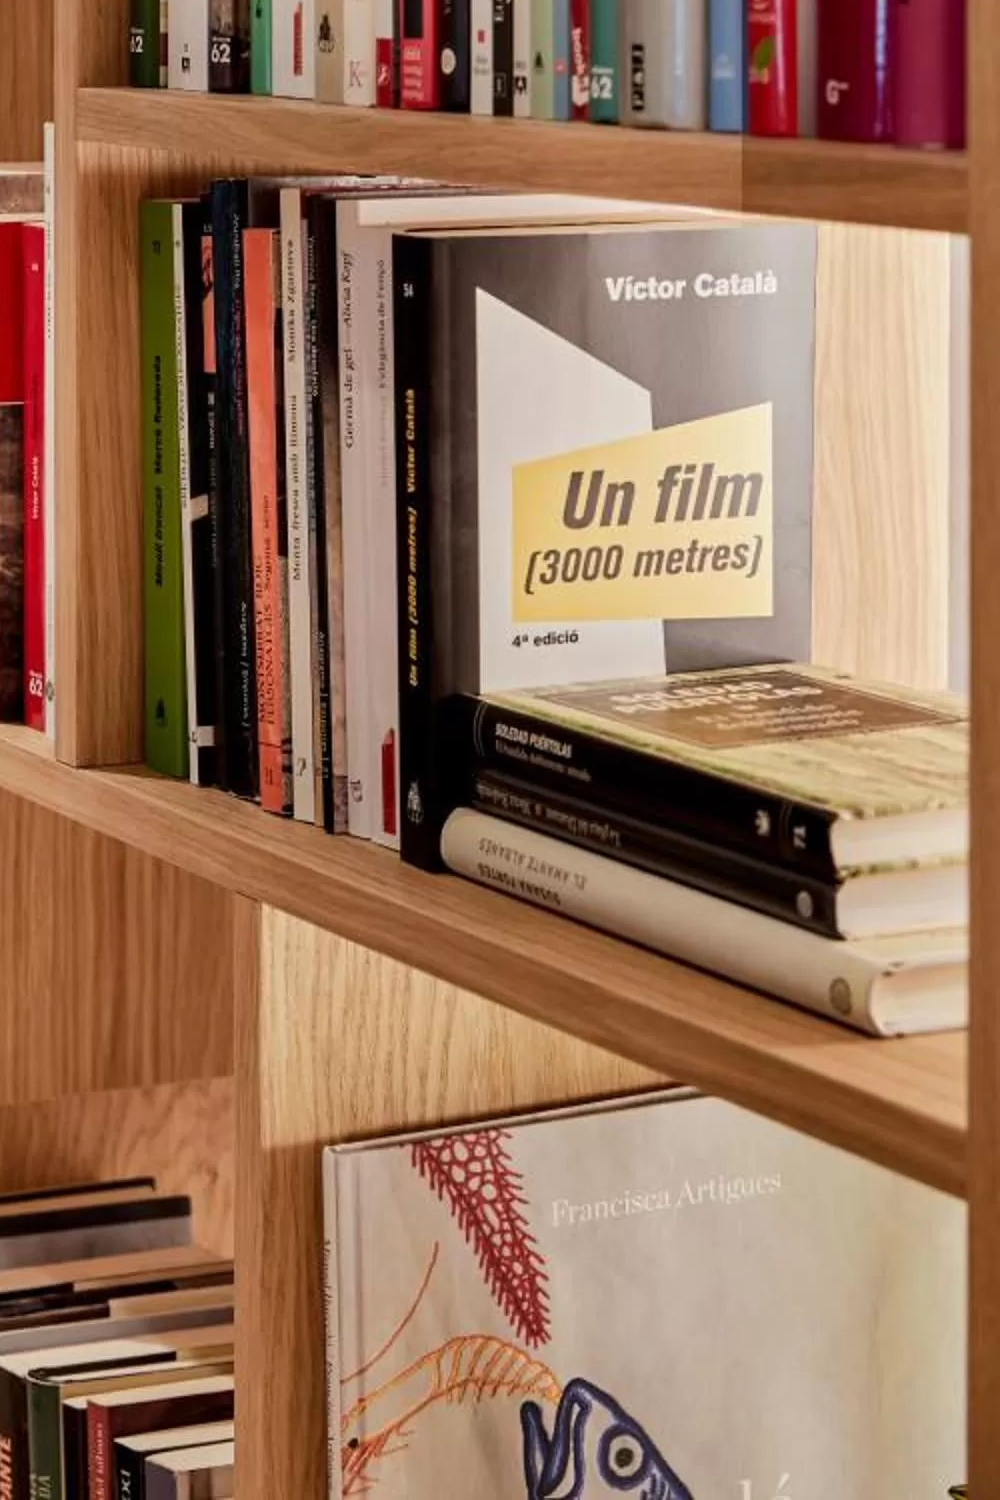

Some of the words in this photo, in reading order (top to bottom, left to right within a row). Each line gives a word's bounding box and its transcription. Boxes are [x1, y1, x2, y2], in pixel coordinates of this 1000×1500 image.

[210, 43, 231, 64] 62
[605, 274, 687, 303] Víctor
[692, 269, 779, 298] Català
[342, 287, 353, 328] Alicia
[342, 348, 355, 371] gel
[342, 377, 352, 392] de
[342, 396, 353, 450] Germà
[404, 388, 416, 442] Català
[289, 453, 298, 483] amb
[290, 489, 299, 531] fresca
[562, 469, 636, 531] Un
[653, 462, 764, 524] film
[291, 537, 300, 581] Menta
[522, 544, 625, 595] (3000
[632, 534, 763, 579] metres)
[408, 627, 418, 662] film
[511, 633, 529, 648] 4ª
[532, 629, 579, 647] edició
[410, 664, 419, 688] Un
[551, 1188, 670, 1228] Francisca
[678, 1171, 782, 1205] Artigues
